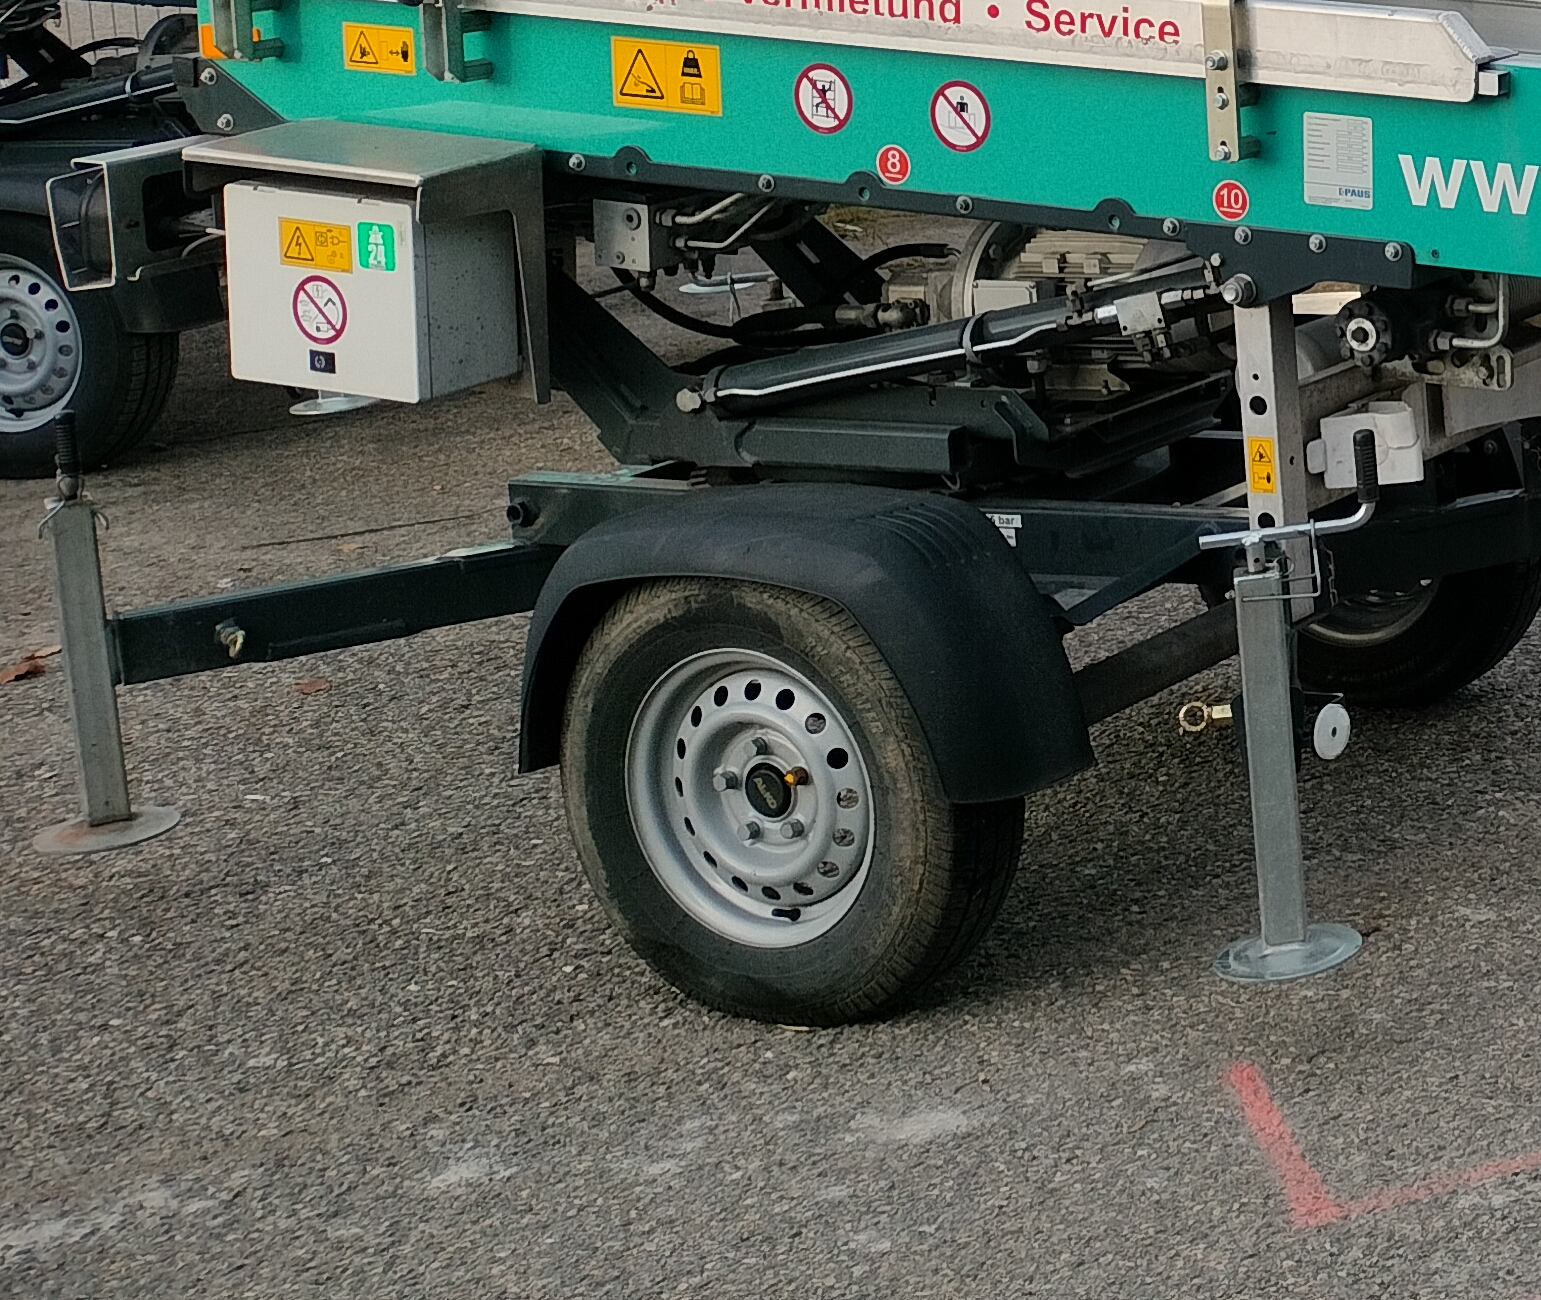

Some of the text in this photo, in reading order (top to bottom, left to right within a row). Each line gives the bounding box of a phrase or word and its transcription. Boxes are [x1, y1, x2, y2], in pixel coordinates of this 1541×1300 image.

[886, 149, 902, 173] 8
[1218, 186, 1243, 210] 10
[998, 516, 1015, 525] bar
